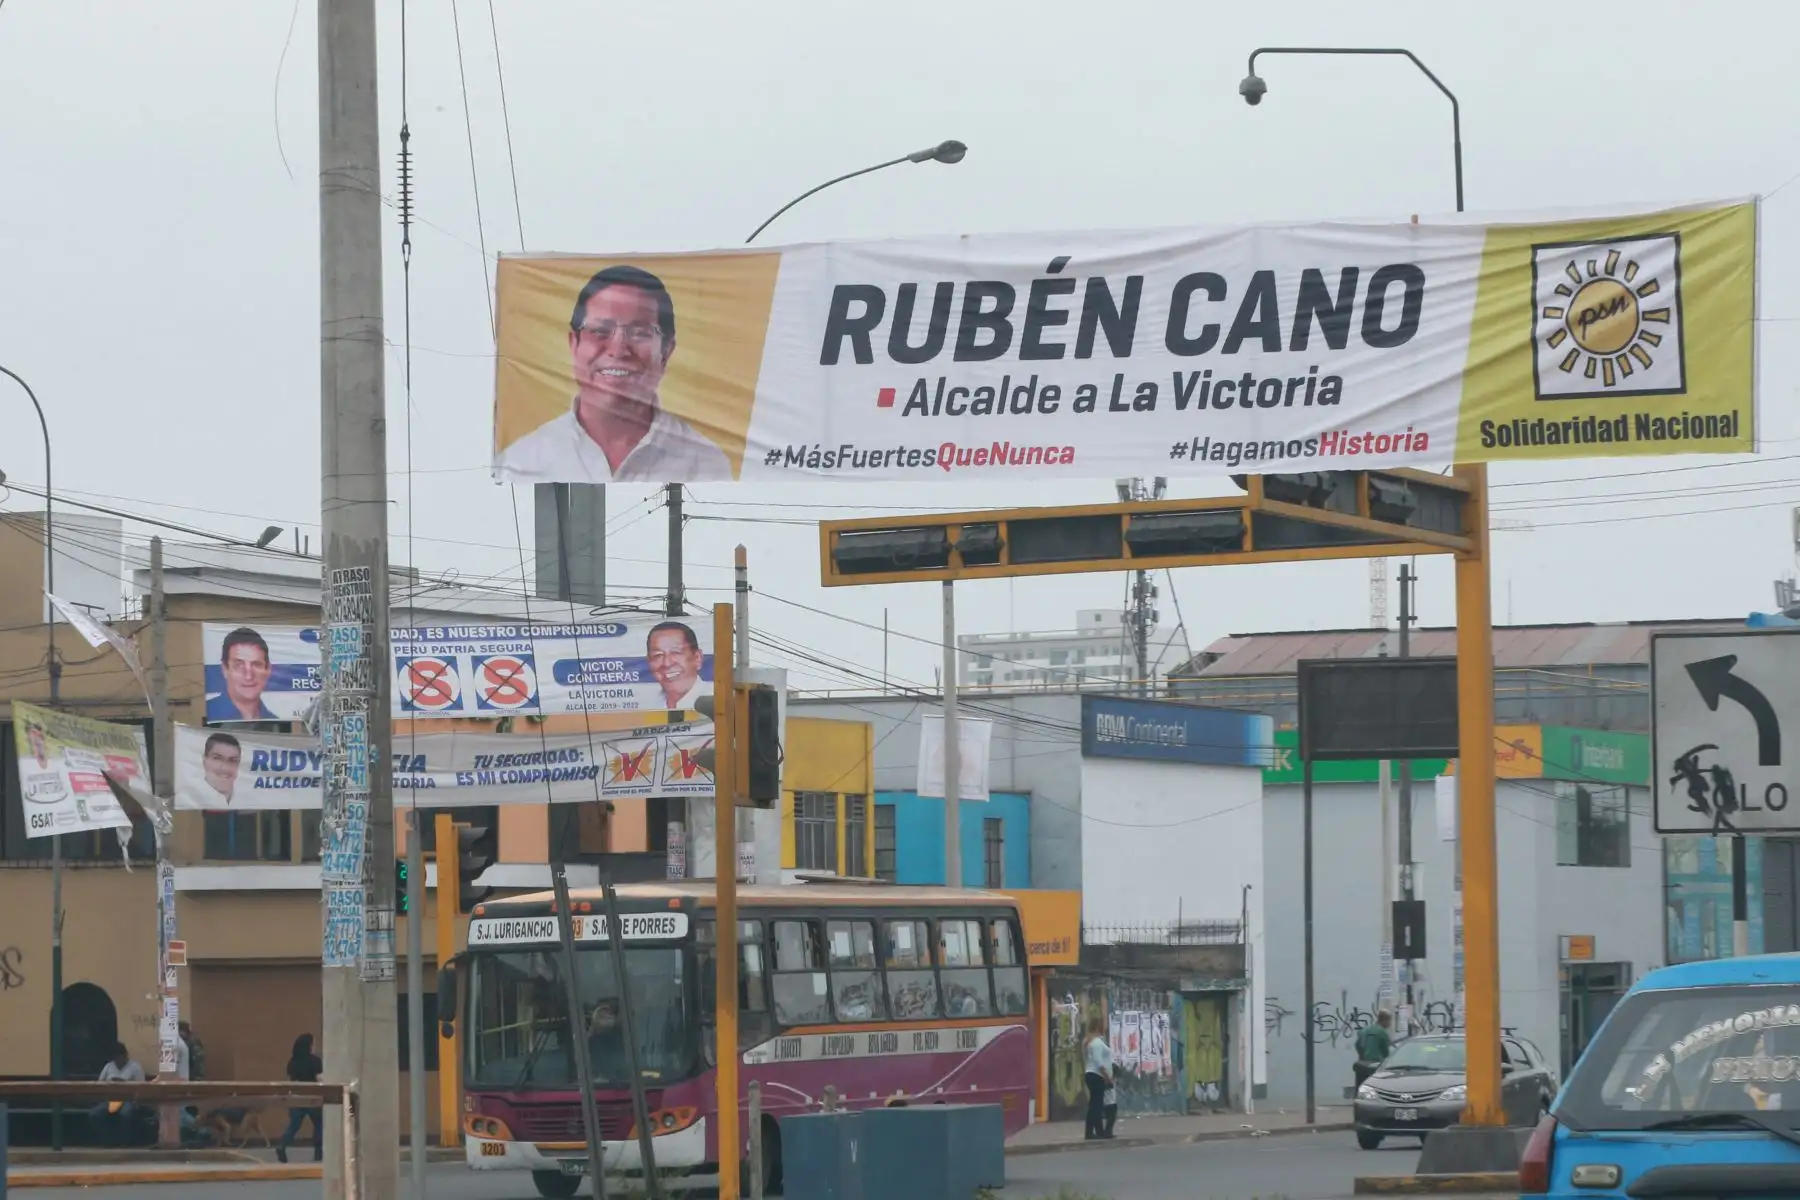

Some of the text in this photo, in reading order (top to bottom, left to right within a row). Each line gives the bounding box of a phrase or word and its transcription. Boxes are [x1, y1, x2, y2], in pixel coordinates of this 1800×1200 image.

[820, 256, 1425, 366] RUBÉN CANO
[902, 364, 1343, 417] Alcalde a La Victoria
[1480, 409, 1740, 449] Solidaridad Nacional
[1169, 426, 1430, 467] #HagamosHistoria
[763, 441, 1076, 472] #MásFuertesQueNunca
[427, 627, 444, 639] ES
[449, 627, 516, 638] NUESTRO
[521, 624, 617, 637] COMPROMISO
[432, 645, 476, 655] PATRIA
[480, 643, 533, 653] SEGURA
[567, 672, 640, 683] CONTRERAS
[569, 689, 634, 700] LA VICTORIA
[251, 750, 323, 772] RUDY
[474, 748, 584, 769] TU SEGURIDAD:
[254, 776, 322, 789] ALCALDE
[456, 765, 599, 786] ES MI COMPROMISO
[31, 812, 54, 829] GSAT
[494, 921, 554, 939] LURIGANCHO
[632, 917, 676, 934] PORRES
[481, 1142, 505, 1156] 3203
